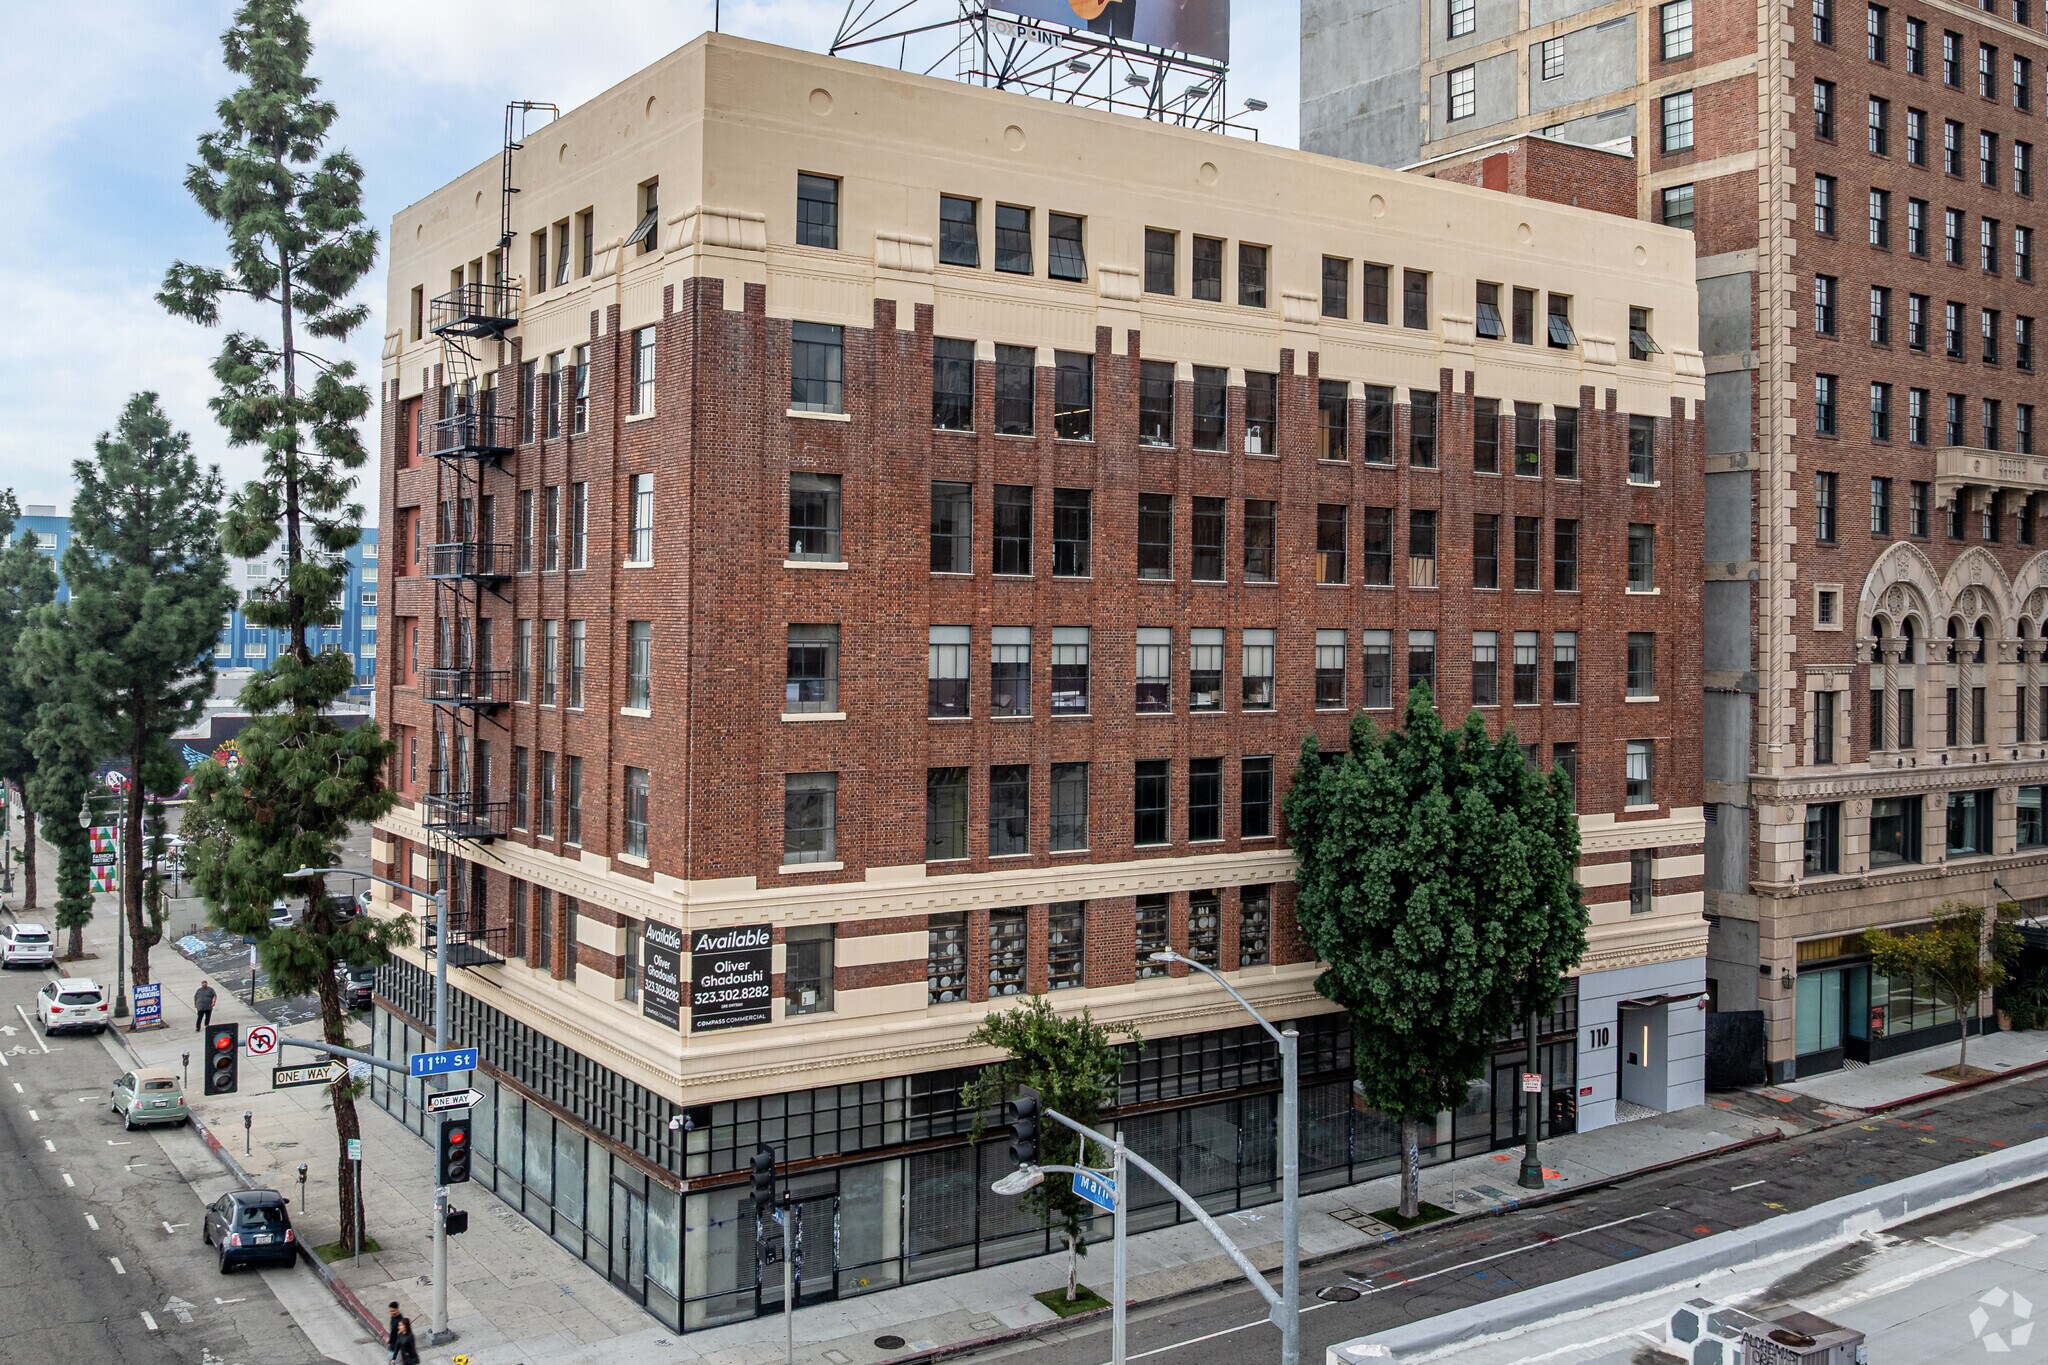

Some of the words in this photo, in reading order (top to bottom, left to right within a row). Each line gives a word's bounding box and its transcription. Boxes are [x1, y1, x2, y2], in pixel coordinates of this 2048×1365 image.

[646, 924, 681, 949] Available
[695, 929, 770, 951] Available
[653, 954, 671, 970] Oliver
[714, 961, 751, 973] Oliver
[647, 964, 677, 986] Ghadoushi
[701, 970, 764, 987] Ghadoushi
[135, 990, 160, 1000] PARKING
[136, 985, 158, 994] PUBLIC
[645, 978, 680, 1003] 323.302.8282
[694, 986, 770, 1005] 323.302.8282
[136, 1005, 158, 1015] $5.00
[696, 1018, 726, 1027] COMPASS
[726, 1014, 767, 1024] COMMERCIAL
[1590, 1027, 1610, 1048] 110
[418, 1055, 447, 1072] 11th
[453, 1054, 471, 1067] St
[277, 1070, 300, 1083] ONE
[307, 1067, 331, 1080] WAY
[433, 1097, 450, 1106] ONE
[452, 1095, 469, 1103] WAY
